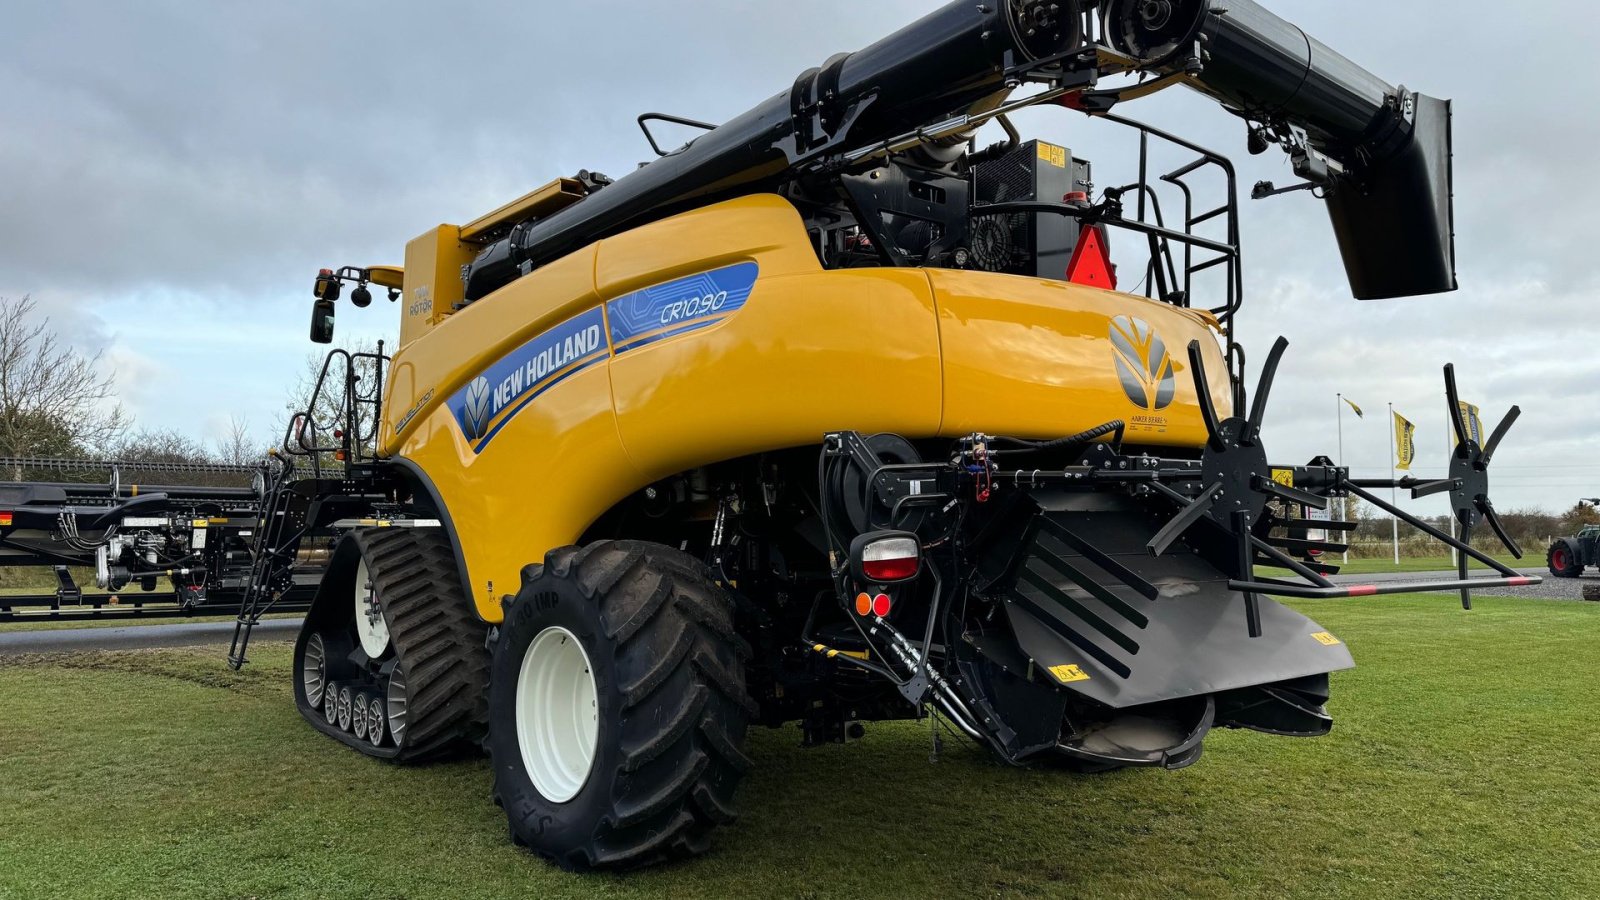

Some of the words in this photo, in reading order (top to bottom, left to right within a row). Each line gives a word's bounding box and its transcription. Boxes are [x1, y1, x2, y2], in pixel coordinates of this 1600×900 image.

[660, 291, 727, 324] CR10.90
[493, 371, 522, 414] NEW
[526, 323, 600, 382] HOLLAND
